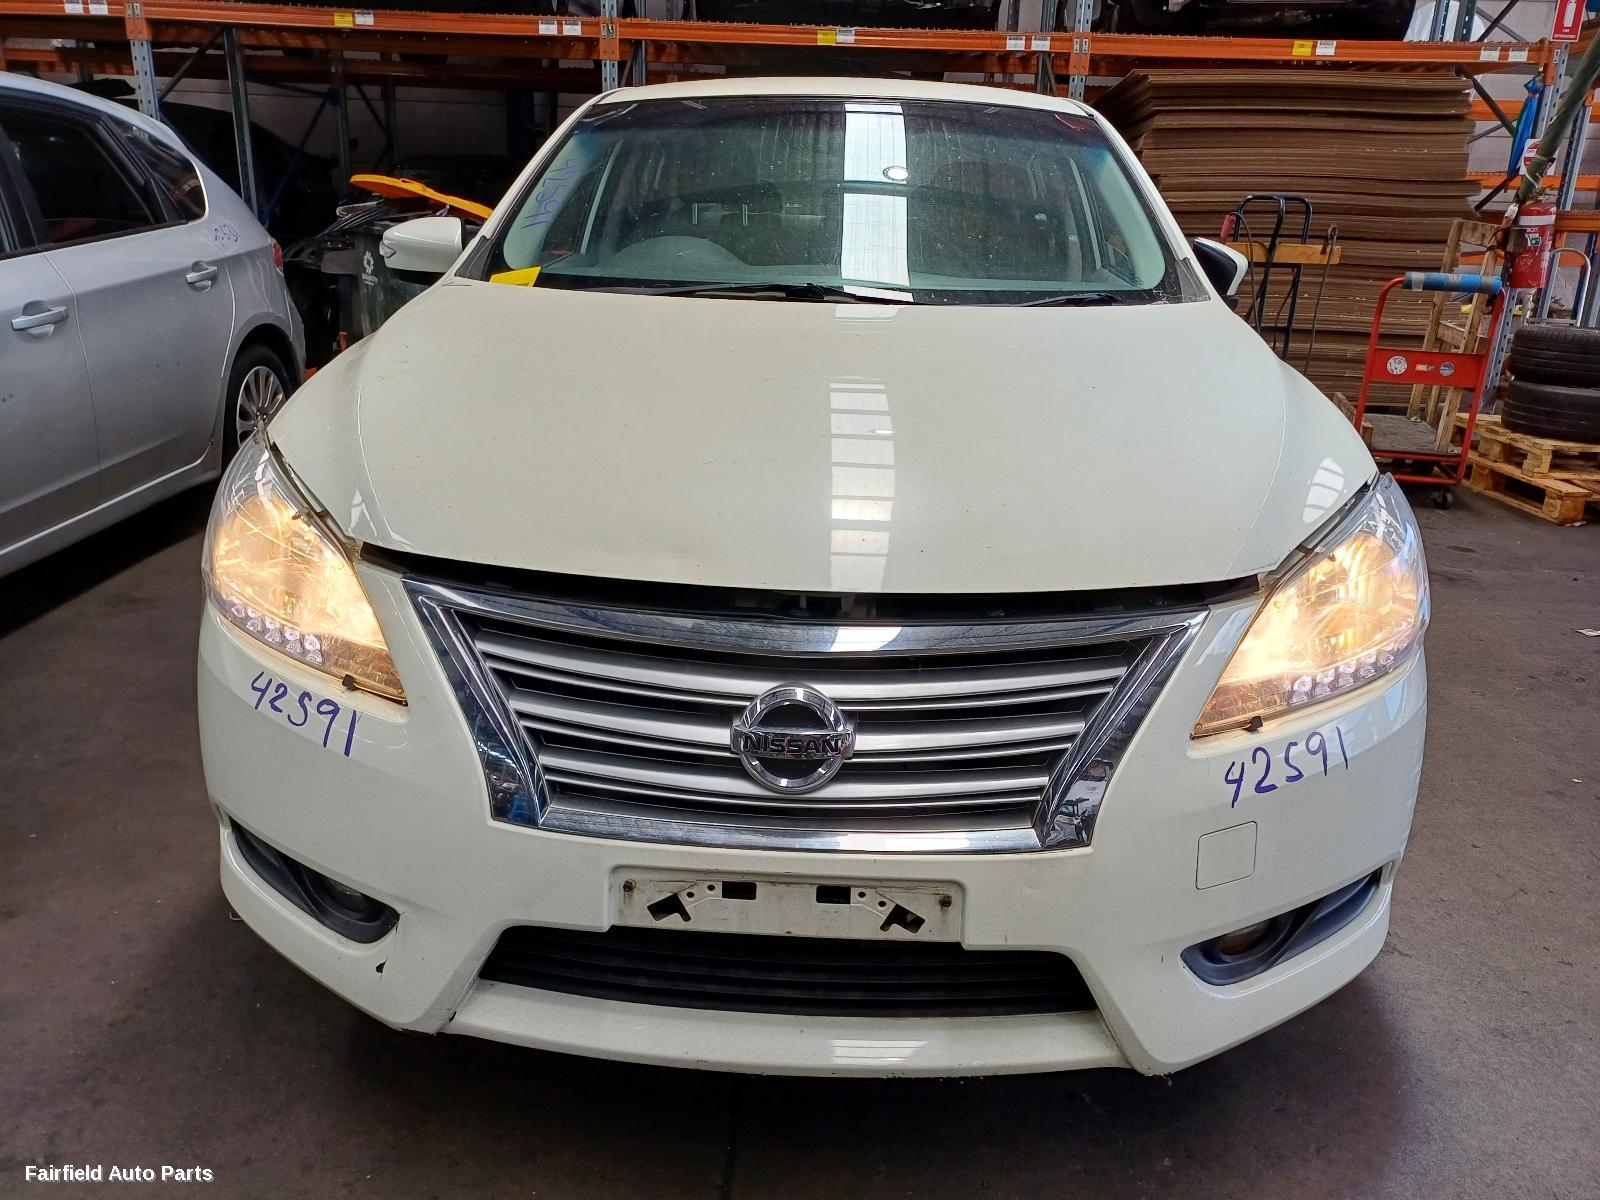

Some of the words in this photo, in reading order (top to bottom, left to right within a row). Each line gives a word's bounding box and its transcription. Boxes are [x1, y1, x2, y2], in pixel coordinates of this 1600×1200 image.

[251, 671, 357, 757] 42591
[742, 735, 841, 753] NISSAN
[1224, 726, 1348, 808] 42591
